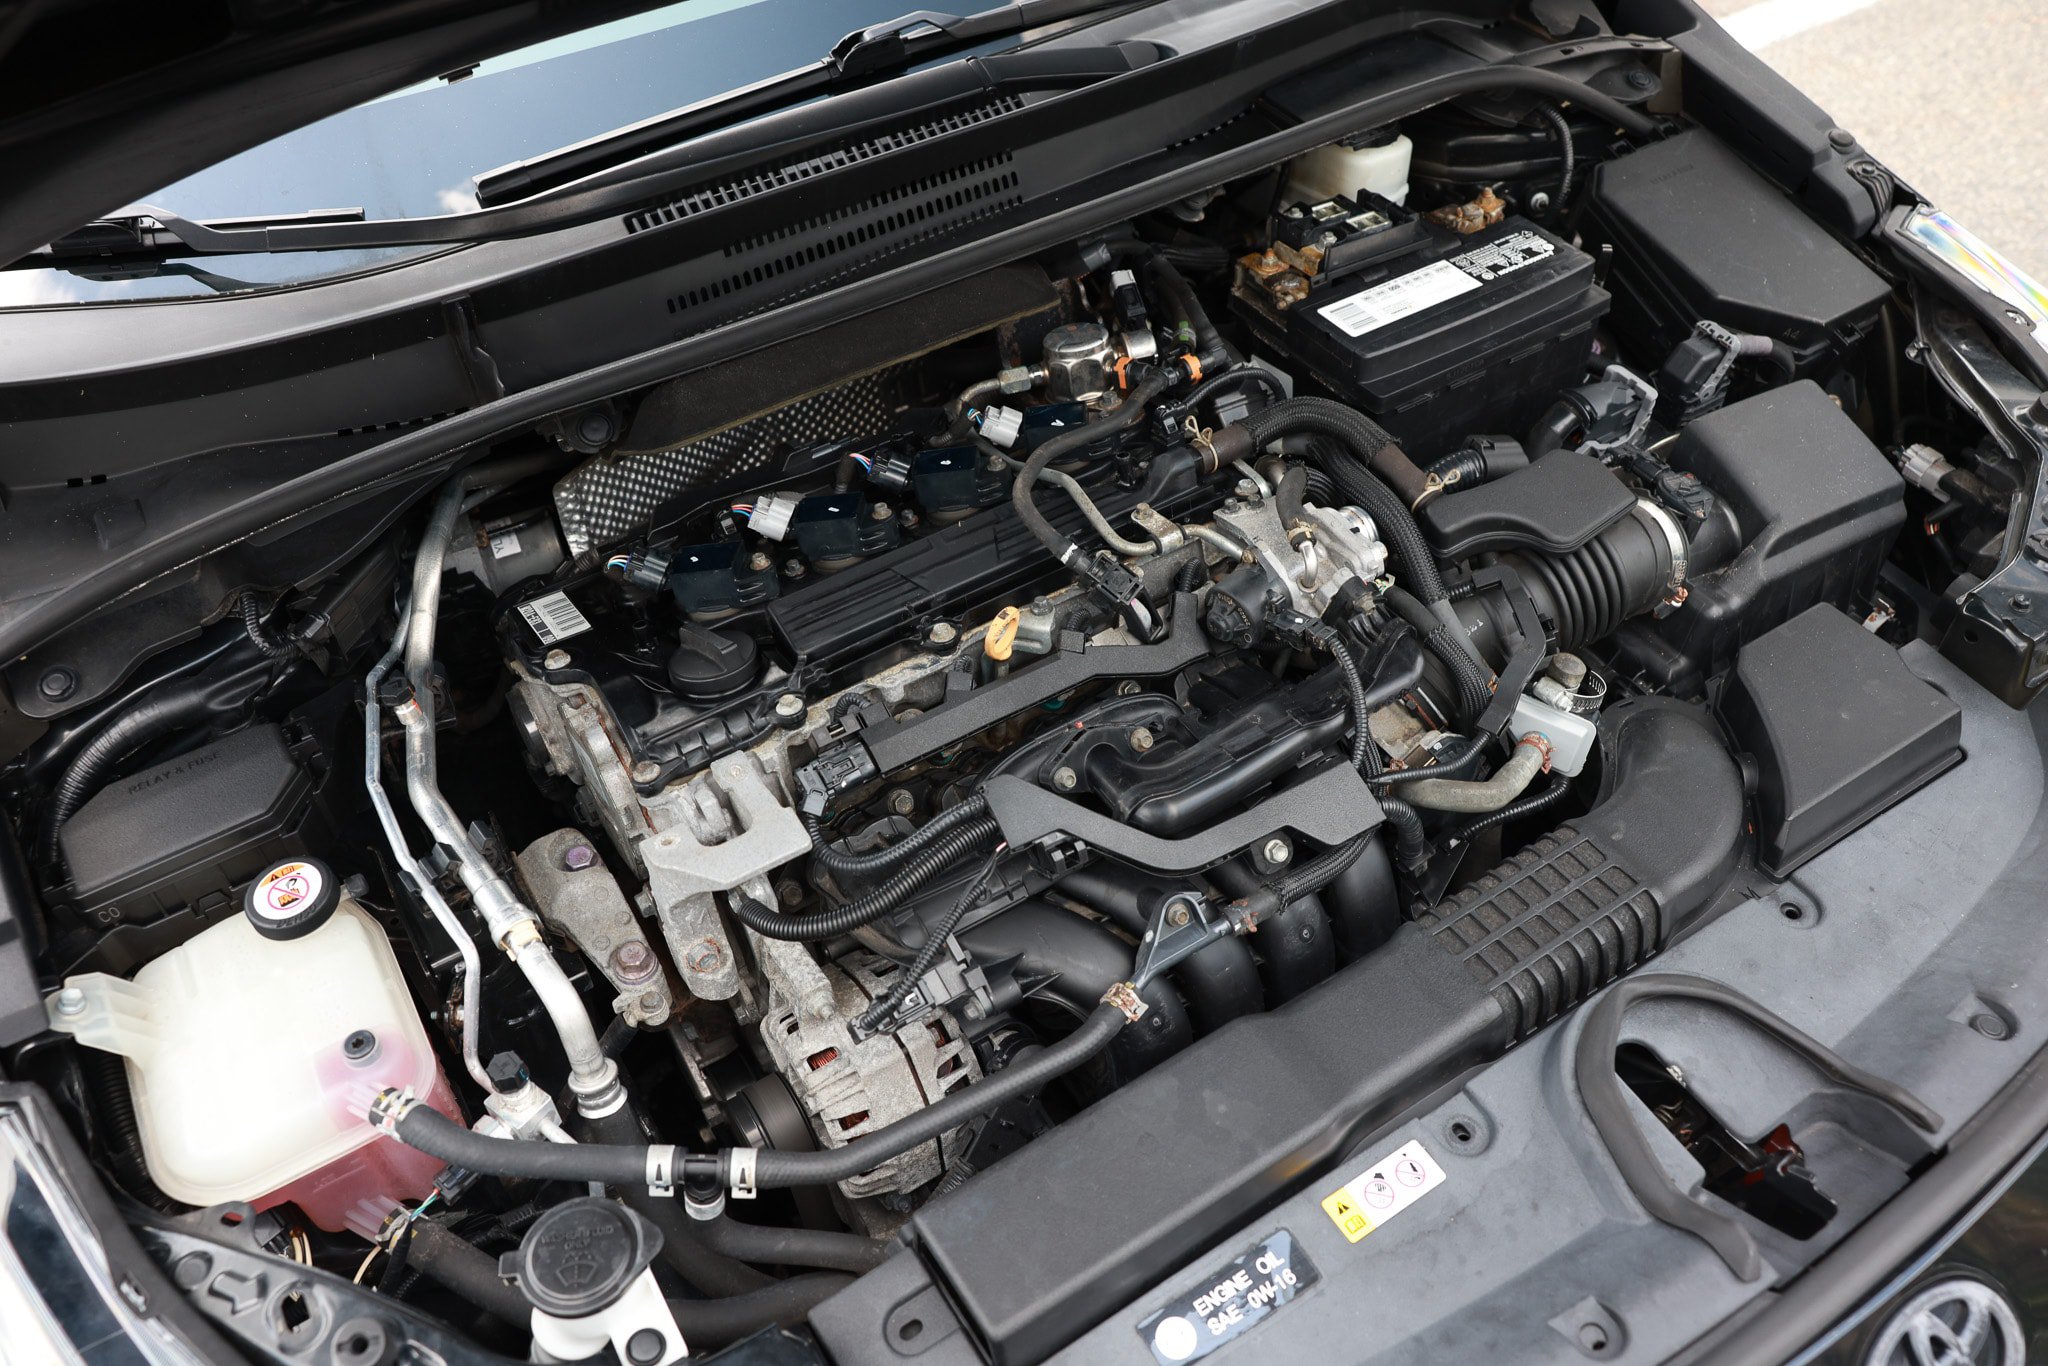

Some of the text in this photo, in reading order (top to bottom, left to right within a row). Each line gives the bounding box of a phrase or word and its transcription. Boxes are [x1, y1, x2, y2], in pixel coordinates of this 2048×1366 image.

[1192, 1251, 1285, 1317] ENGINE OIL
[1206, 1267, 1297, 1336] SAE 0W-16
